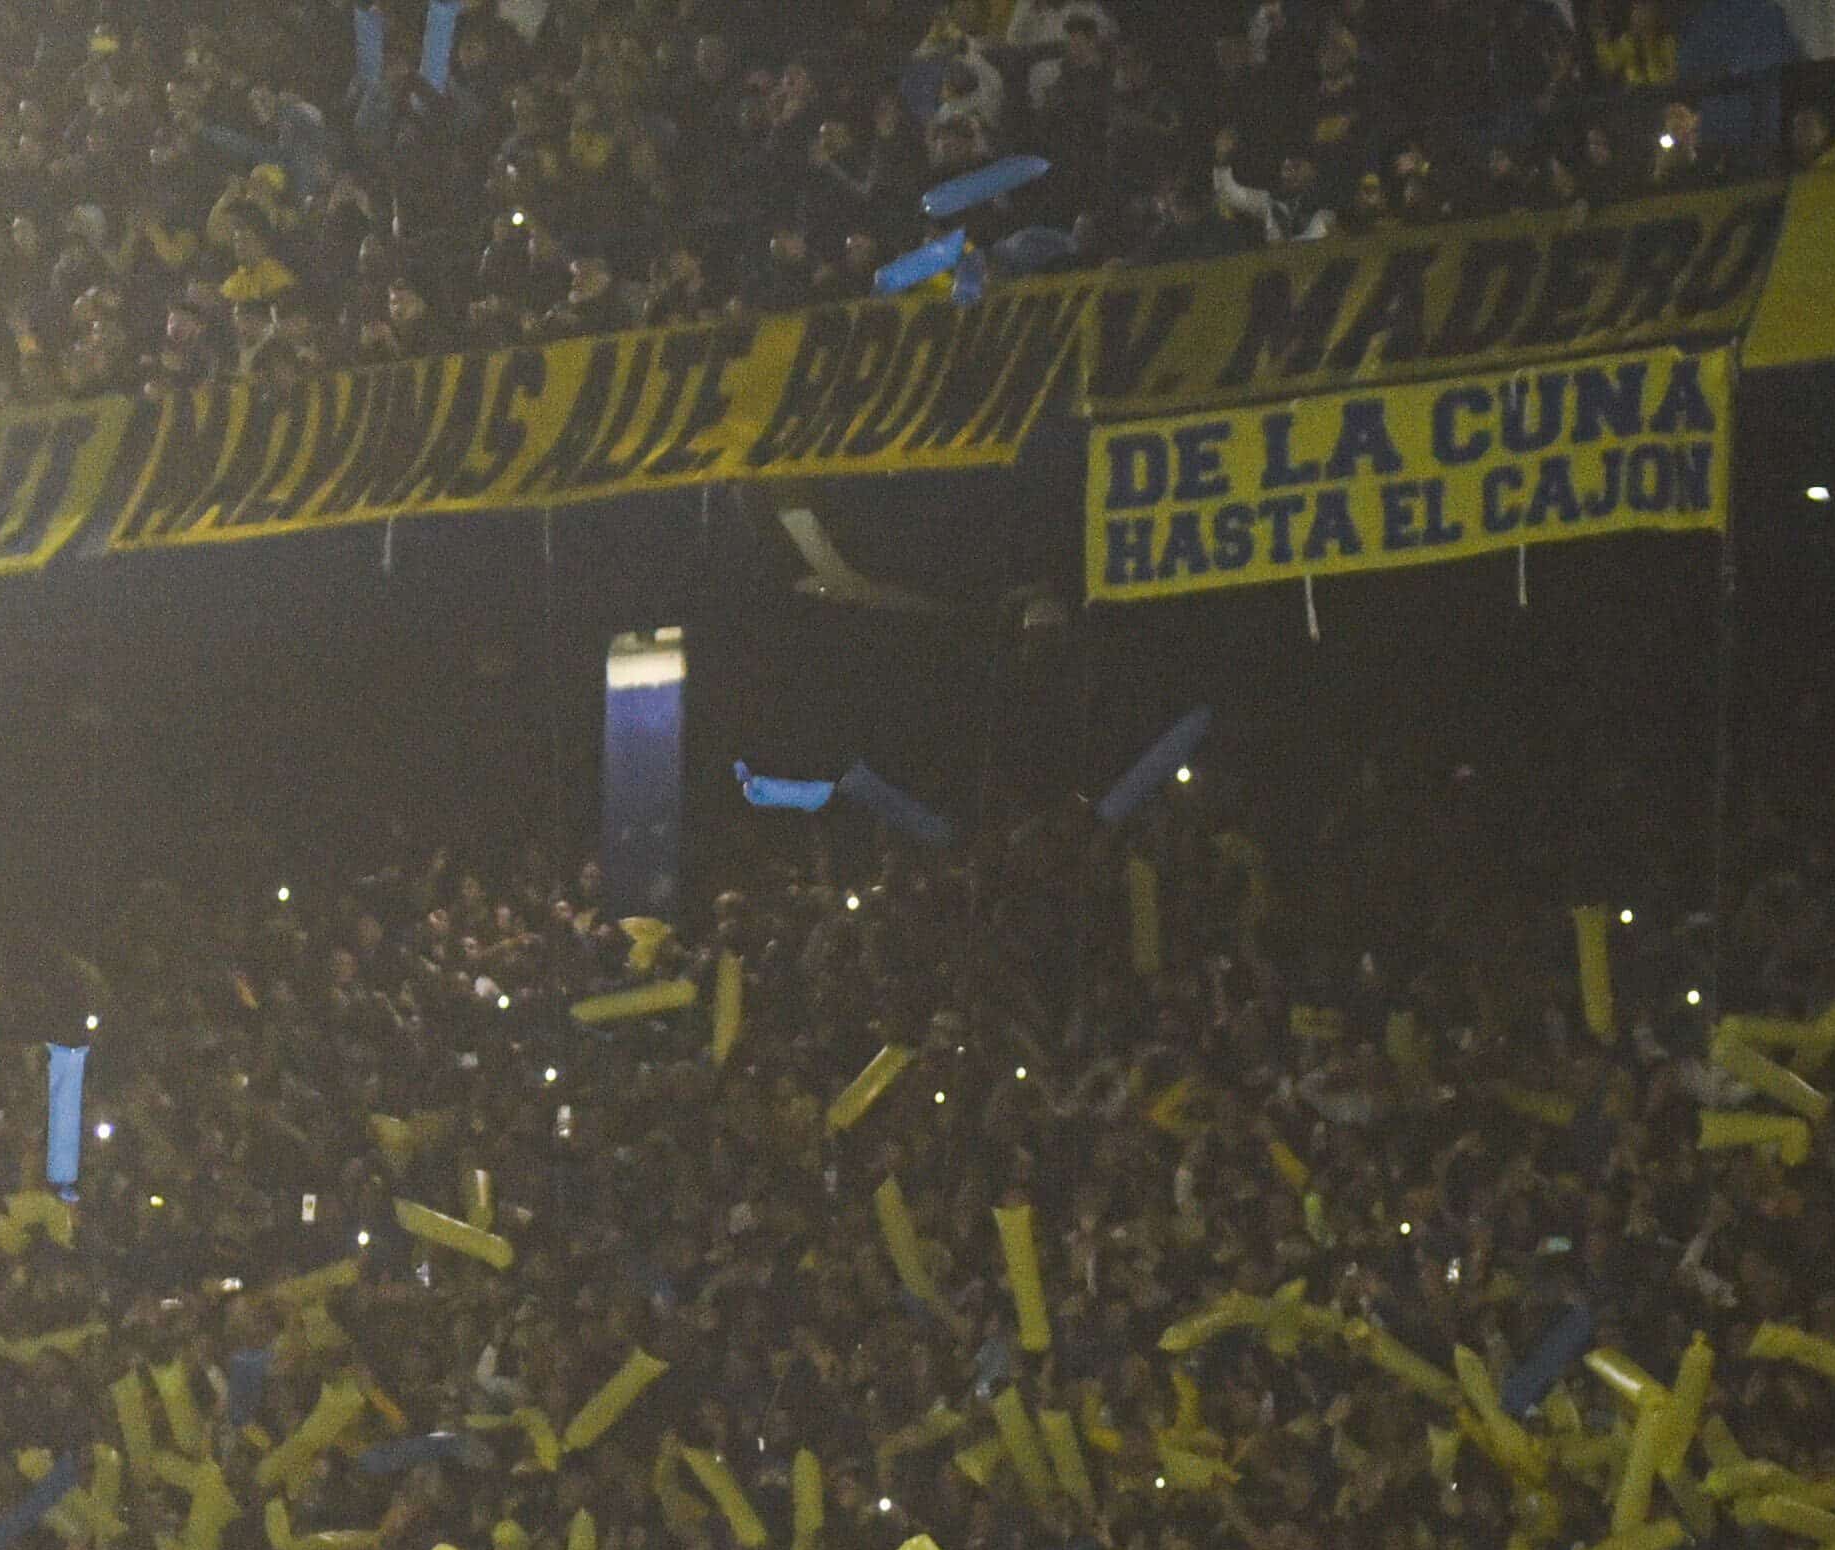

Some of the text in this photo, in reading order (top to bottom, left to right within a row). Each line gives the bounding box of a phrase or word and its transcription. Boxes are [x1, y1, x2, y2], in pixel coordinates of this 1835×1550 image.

[752, 286, 1091, 464] BROWN
[1215, 194, 1786, 387] MADERO
[1103, 441, 1714, 587] HASTA EL CAJON
[1105, 350, 1717, 510] DE LA CUNA
